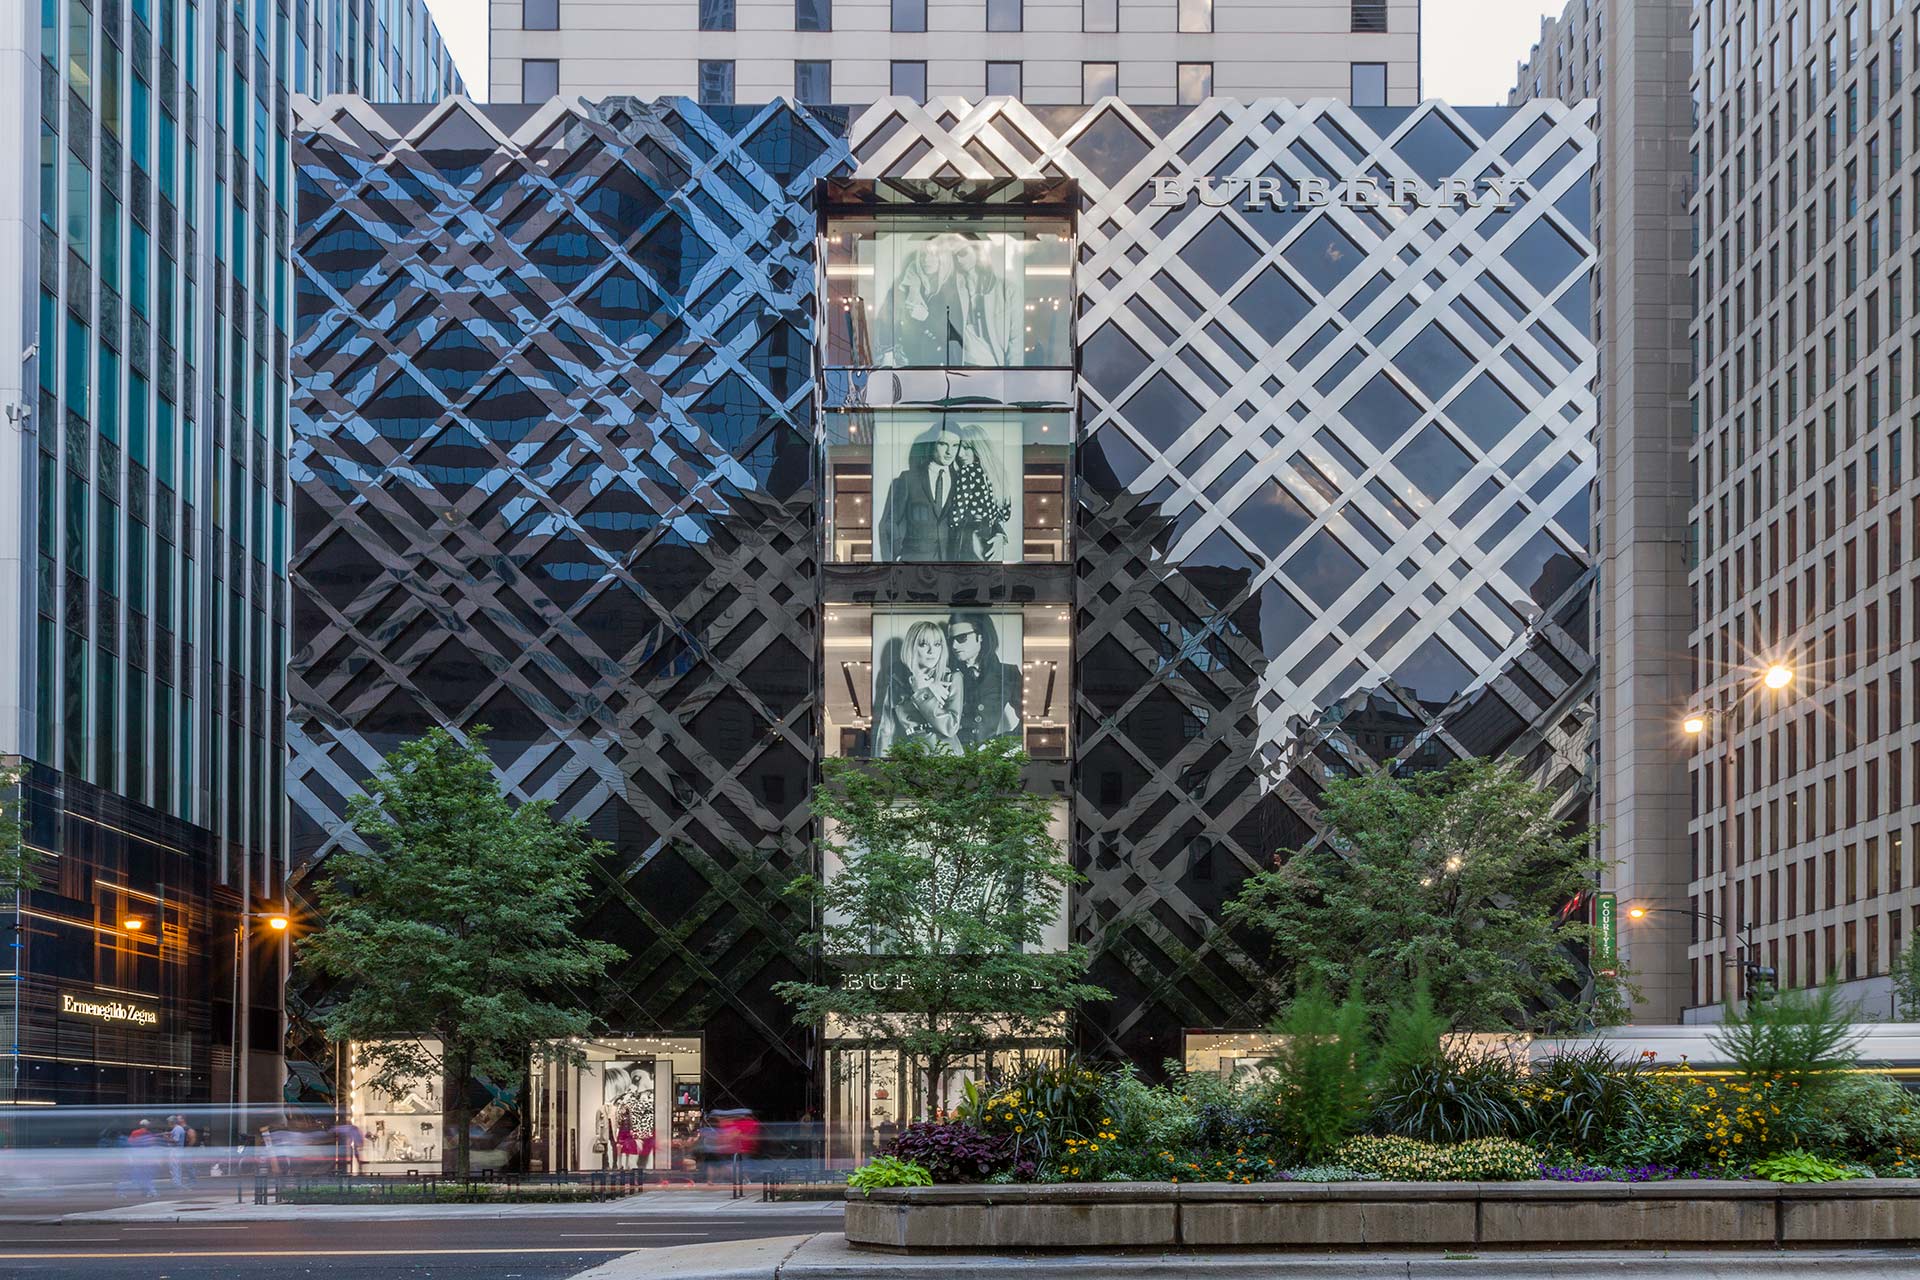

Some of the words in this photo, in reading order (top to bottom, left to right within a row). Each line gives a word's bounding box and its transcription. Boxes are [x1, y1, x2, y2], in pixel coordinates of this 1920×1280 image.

[1149, 176, 1528, 207] BURBERRY
[1602, 901, 1611, 964] COURTY
[63, 995, 127, 1021] Ermenegildo
[127, 1005, 157, 1025] Zegna
